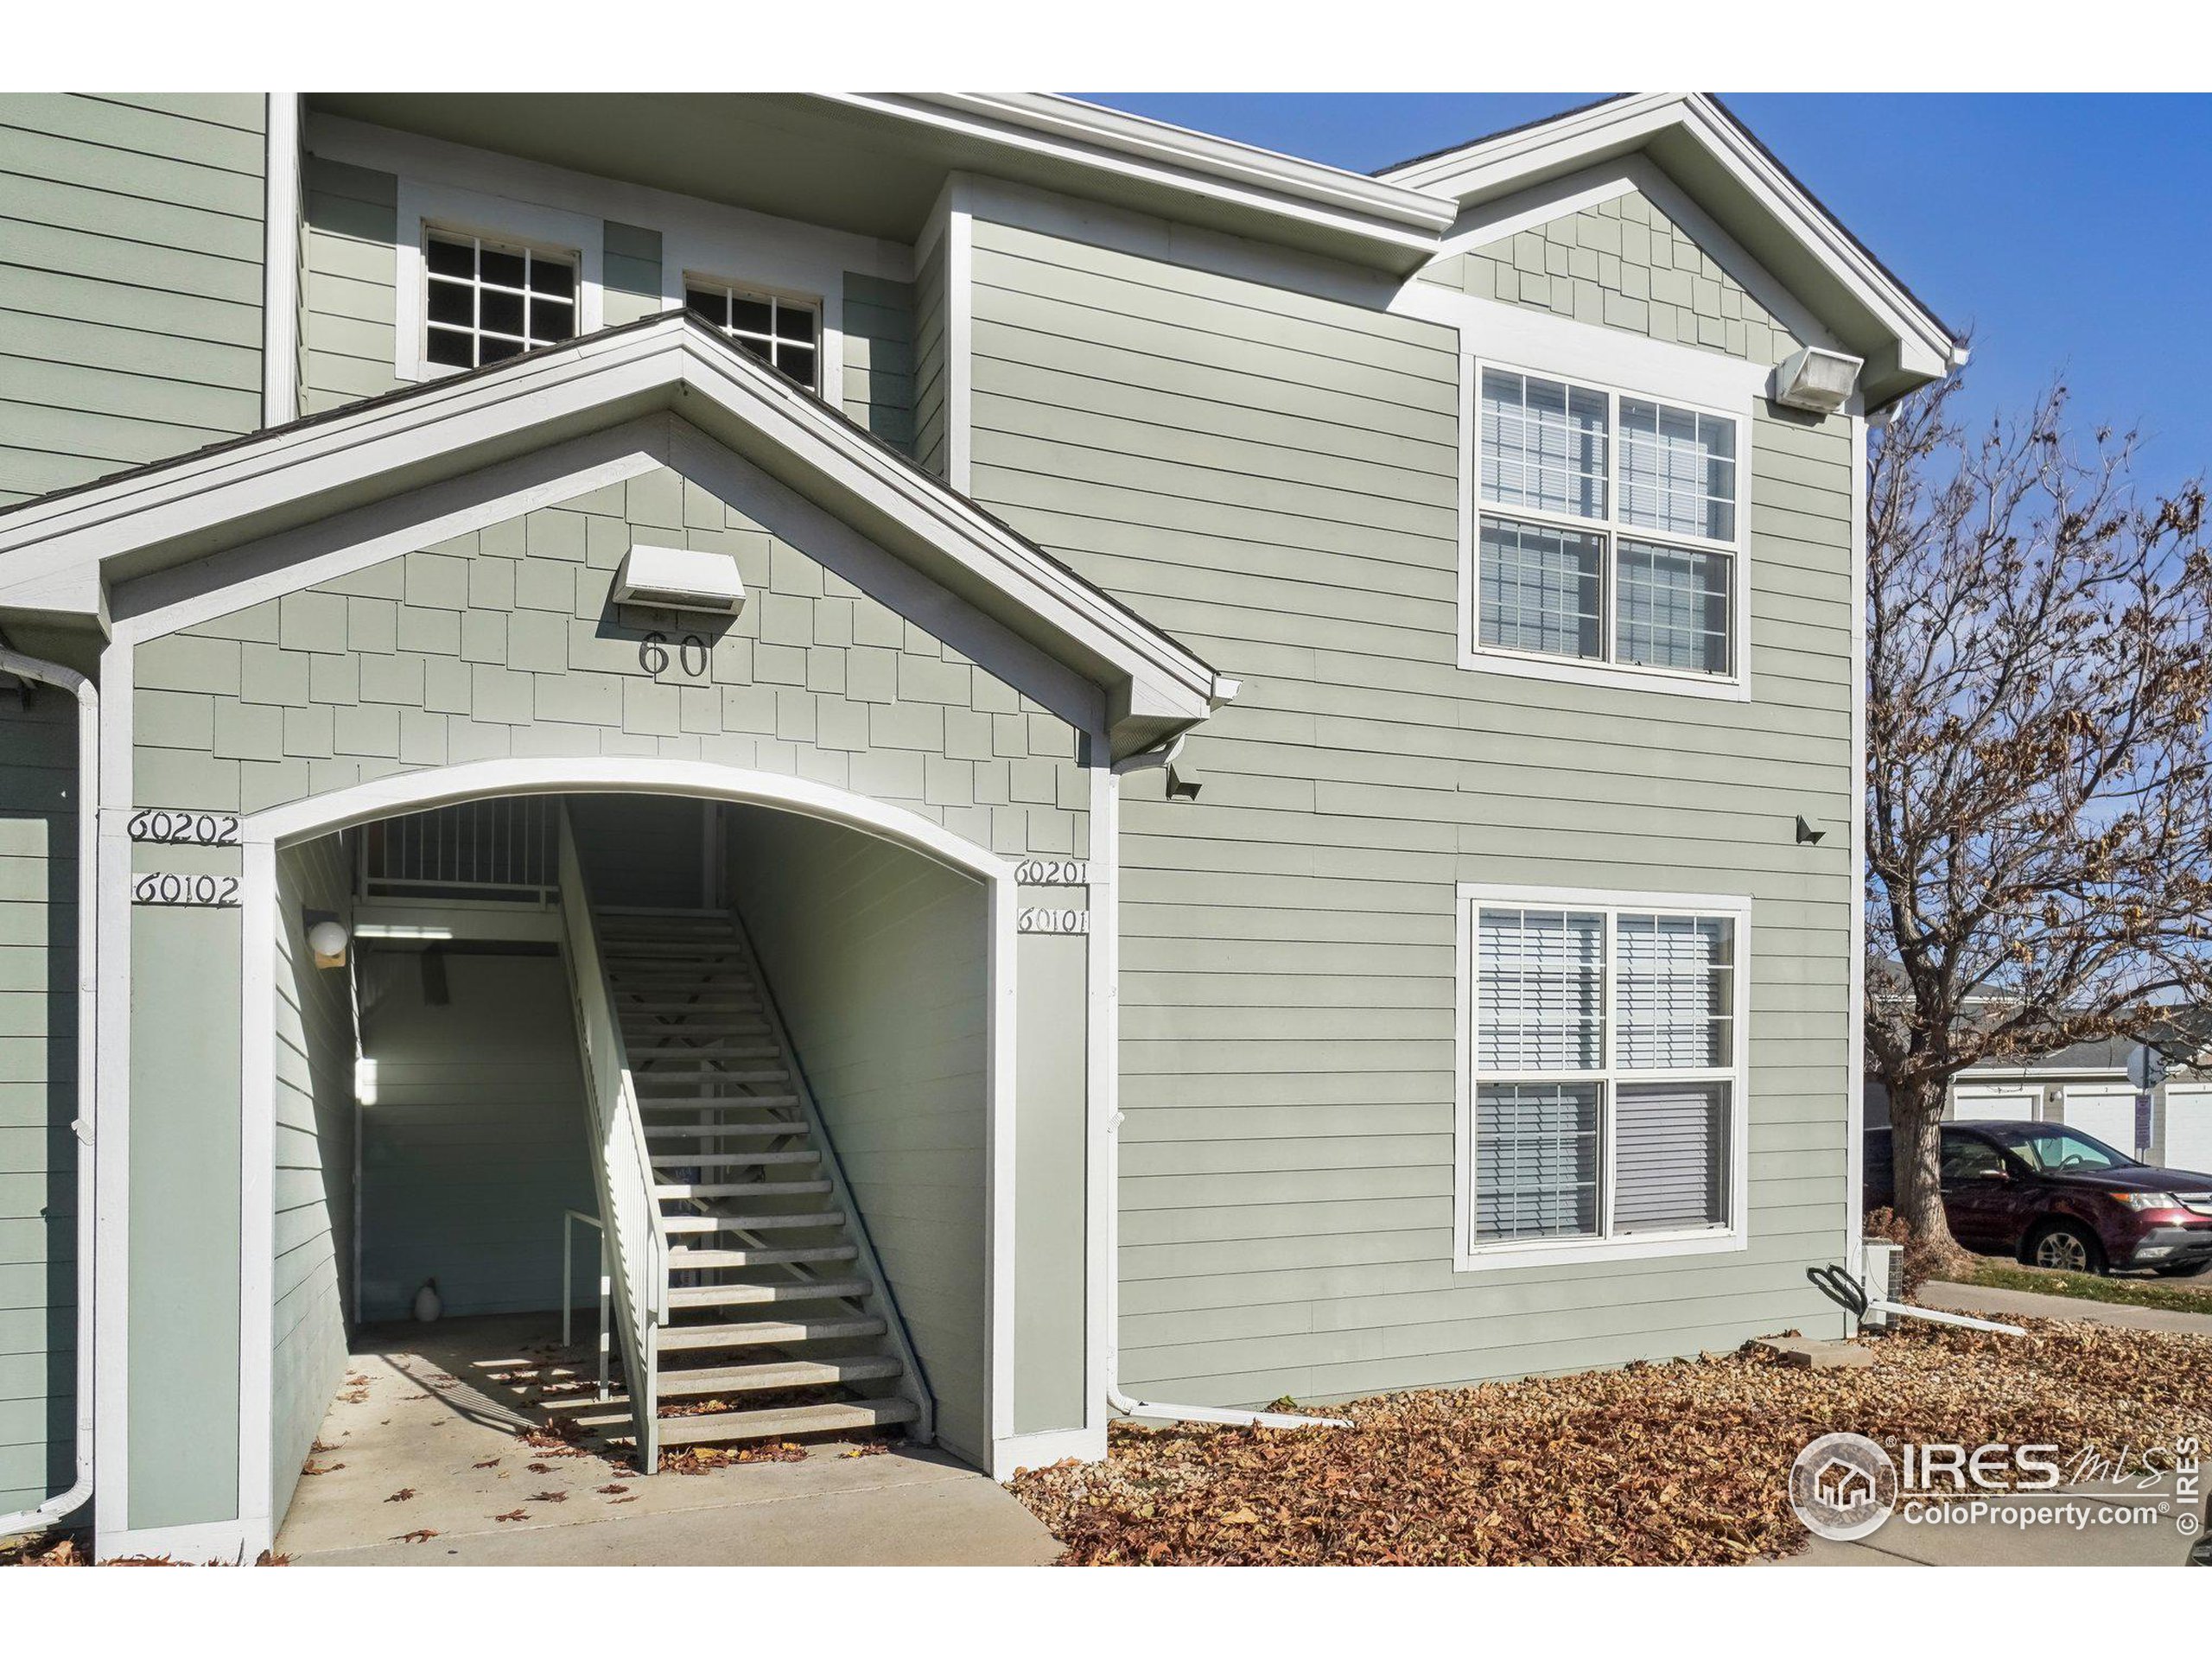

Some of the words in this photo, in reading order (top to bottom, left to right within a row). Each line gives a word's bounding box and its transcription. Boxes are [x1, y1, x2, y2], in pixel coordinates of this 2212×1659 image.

[639, 632, 708, 677] 60
[127, 809, 238, 843] 60202
[135, 872, 239, 905] 60102
[1014, 859, 1087, 885] 60201
[1019, 906, 1086, 932] 60101
